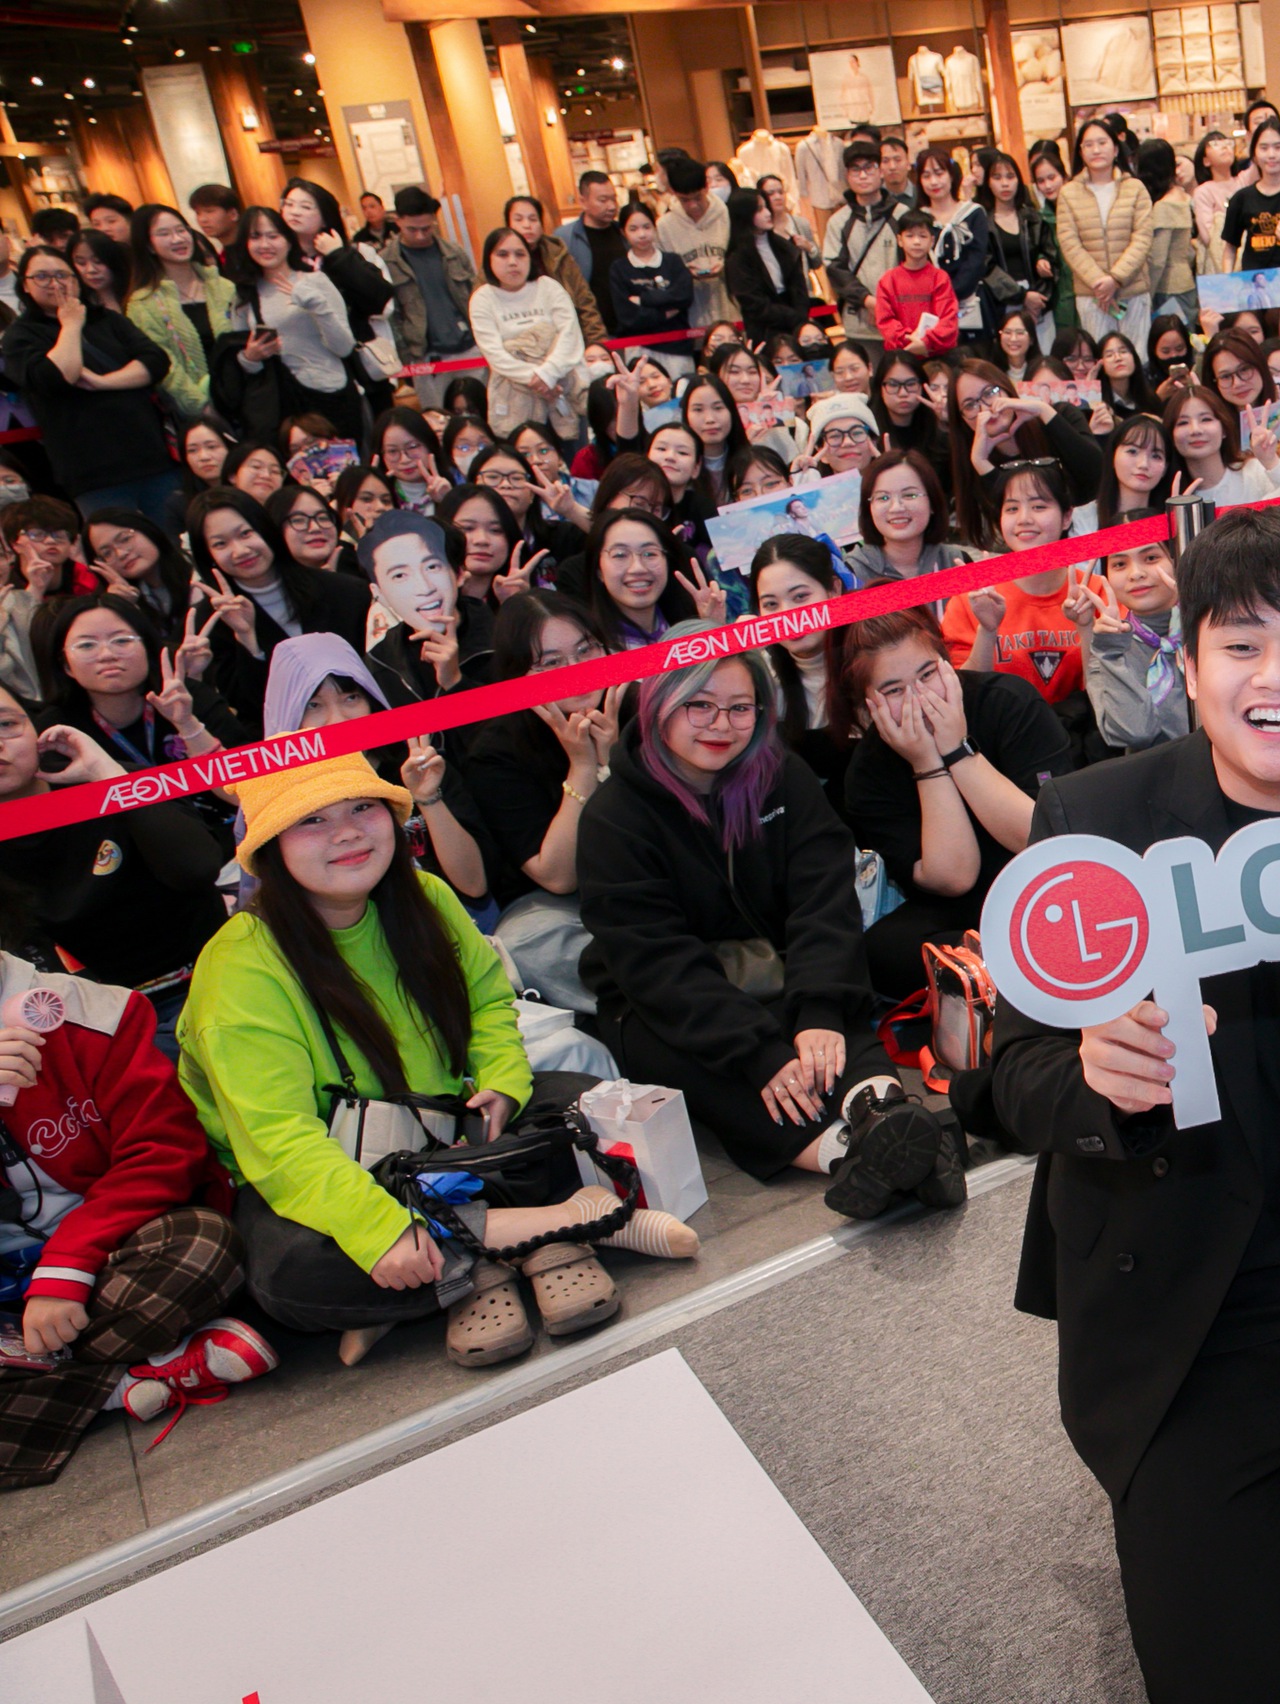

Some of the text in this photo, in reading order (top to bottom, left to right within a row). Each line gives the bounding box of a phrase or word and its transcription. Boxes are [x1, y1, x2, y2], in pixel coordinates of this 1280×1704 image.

[733, 604, 832, 648] VIETNAM
[995, 630, 1081, 664] LAKE TAHO
[193, 732, 327, 786] VIETNAM
